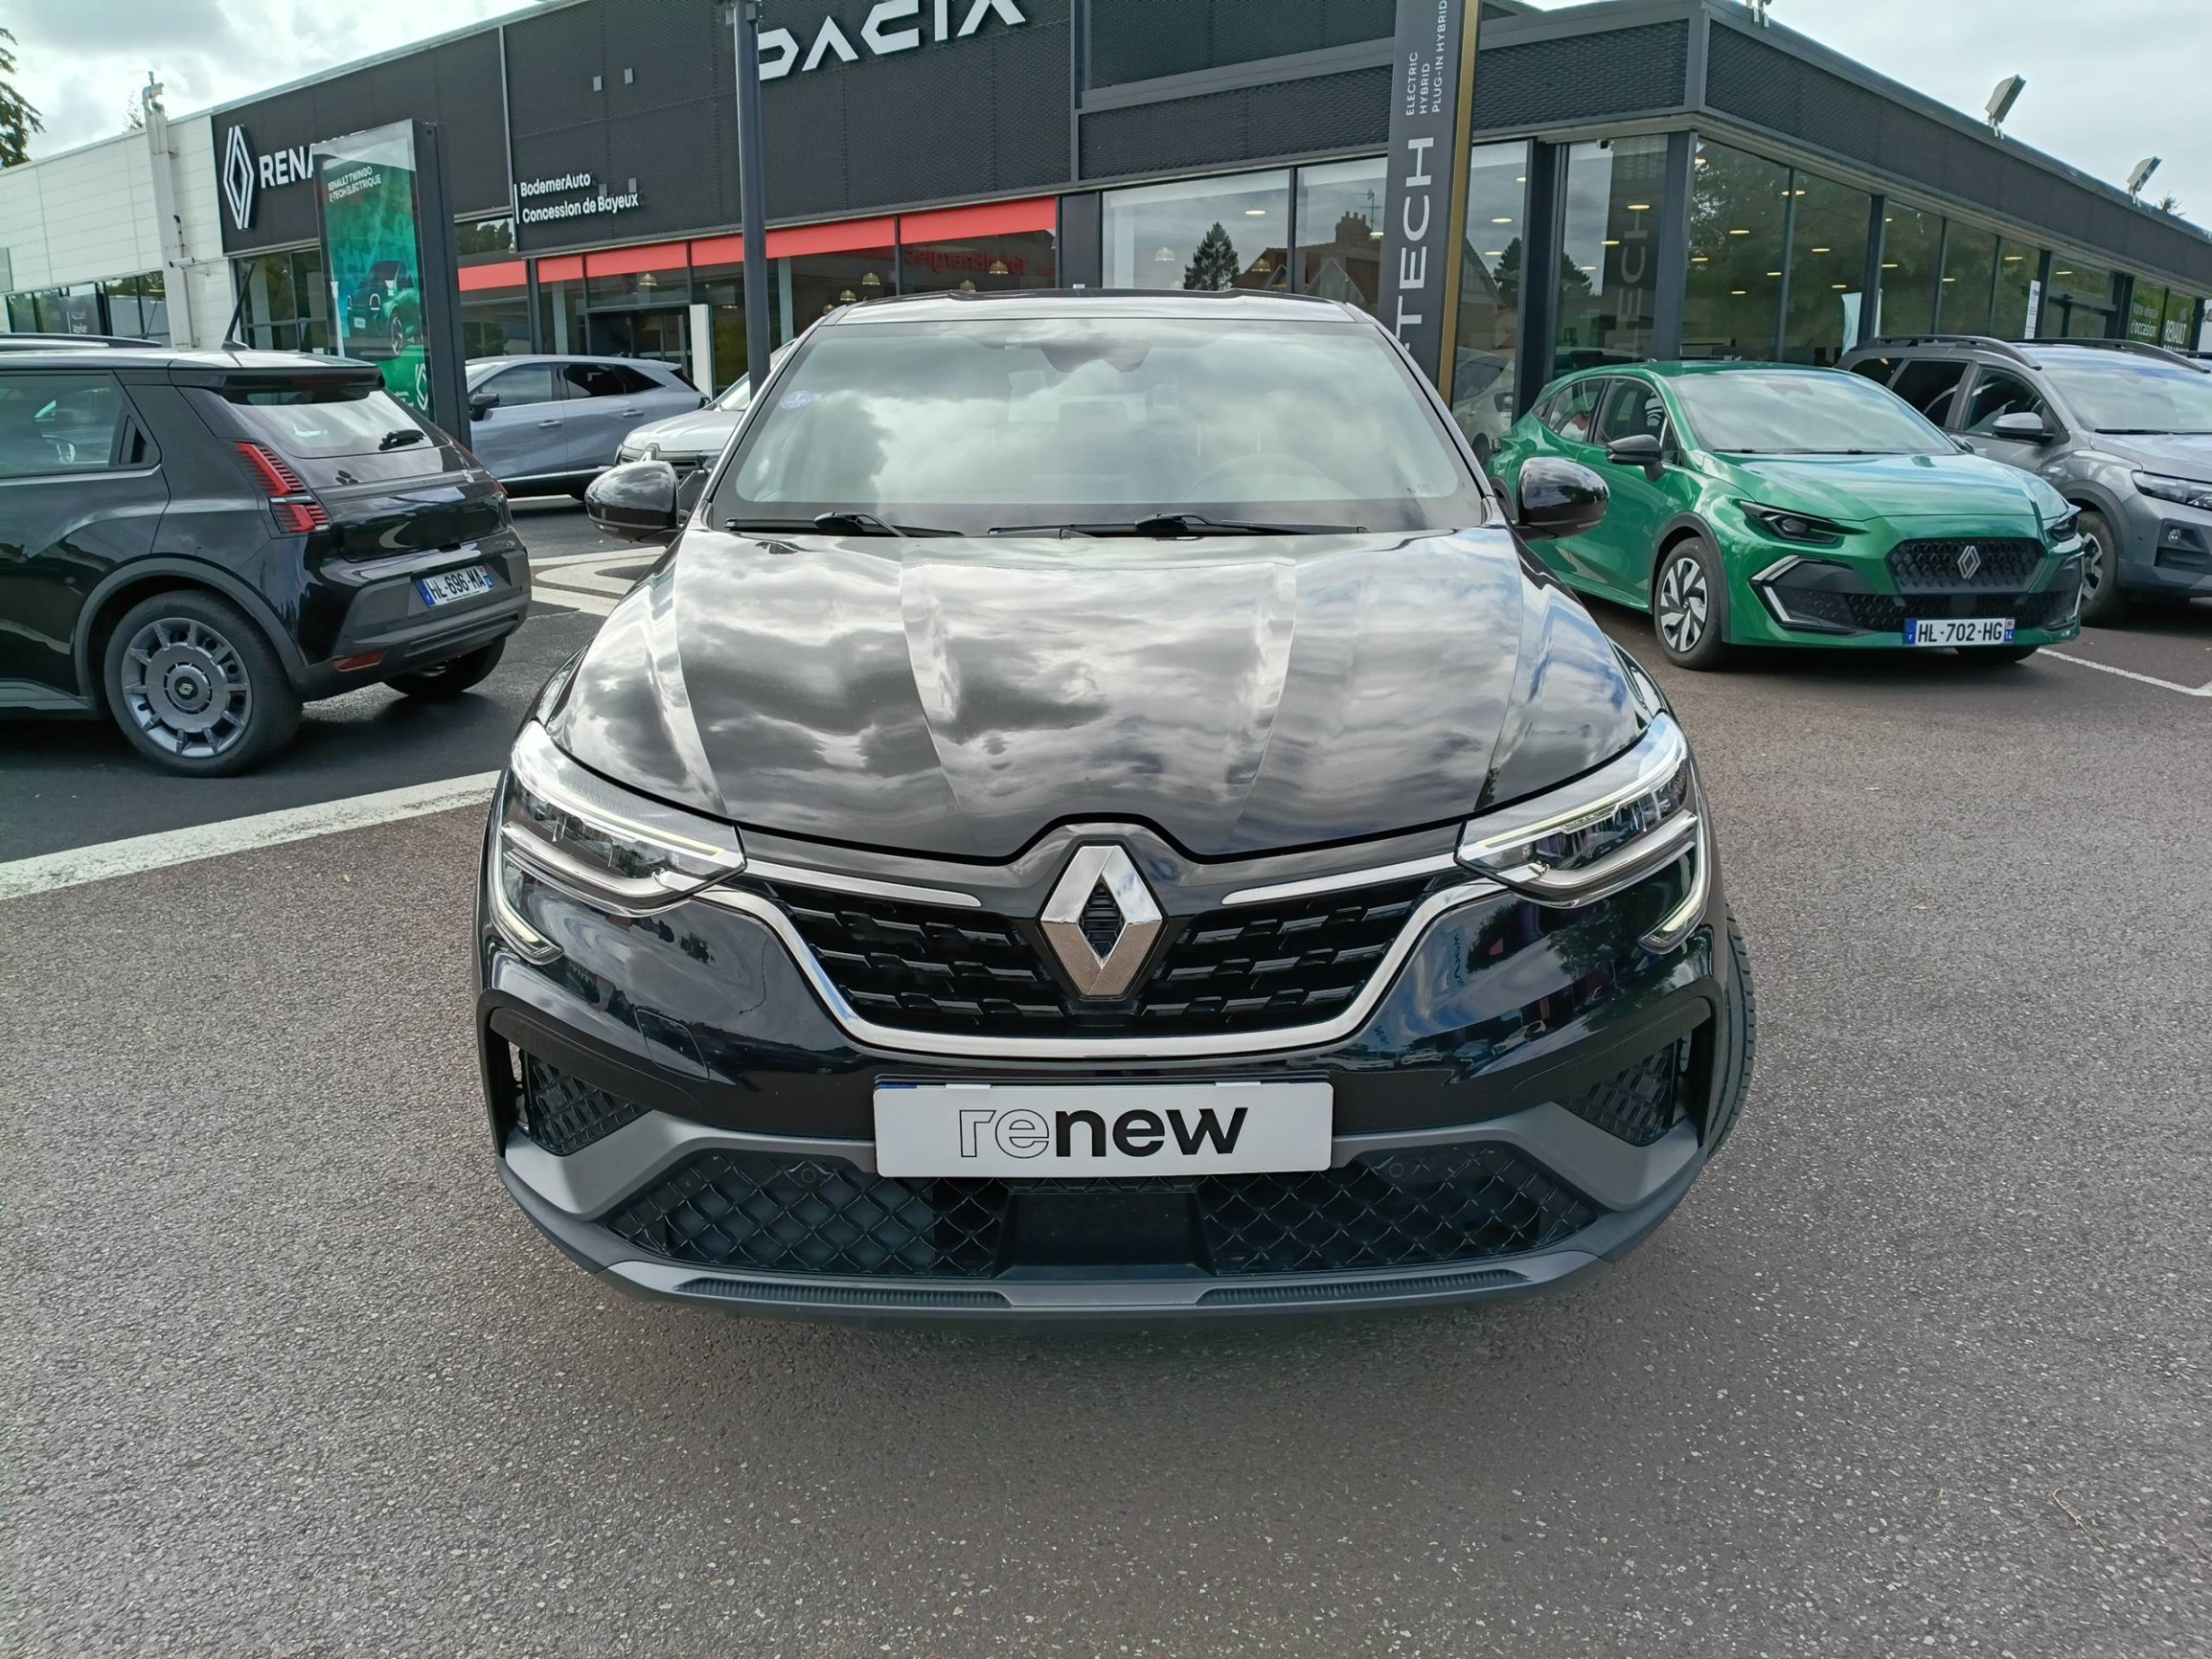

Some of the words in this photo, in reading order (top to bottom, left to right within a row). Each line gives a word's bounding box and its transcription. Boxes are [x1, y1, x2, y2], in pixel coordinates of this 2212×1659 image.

[1436, 0, 1448, 52] HYBRID
[1405, 52, 1418, 116] ELECTRIC
[1419, 62, 1430, 114] HYBRID
[1432, 56, 1444, 113] PLUG-IN
[328, 174, 349, 192] RENAULT
[349, 166, 373, 183] TWINGO
[520, 172, 591, 197] BodemerAuto
[522, 200, 582, 223] Concession
[582, 197, 596, 214] de
[597, 193, 639, 214] Bayeux
[2164, 319, 2187, 344] RENAULT
[1918, 622, 2002, 643] HL-702-HG
[959, 1106, 1248, 1159] renew
